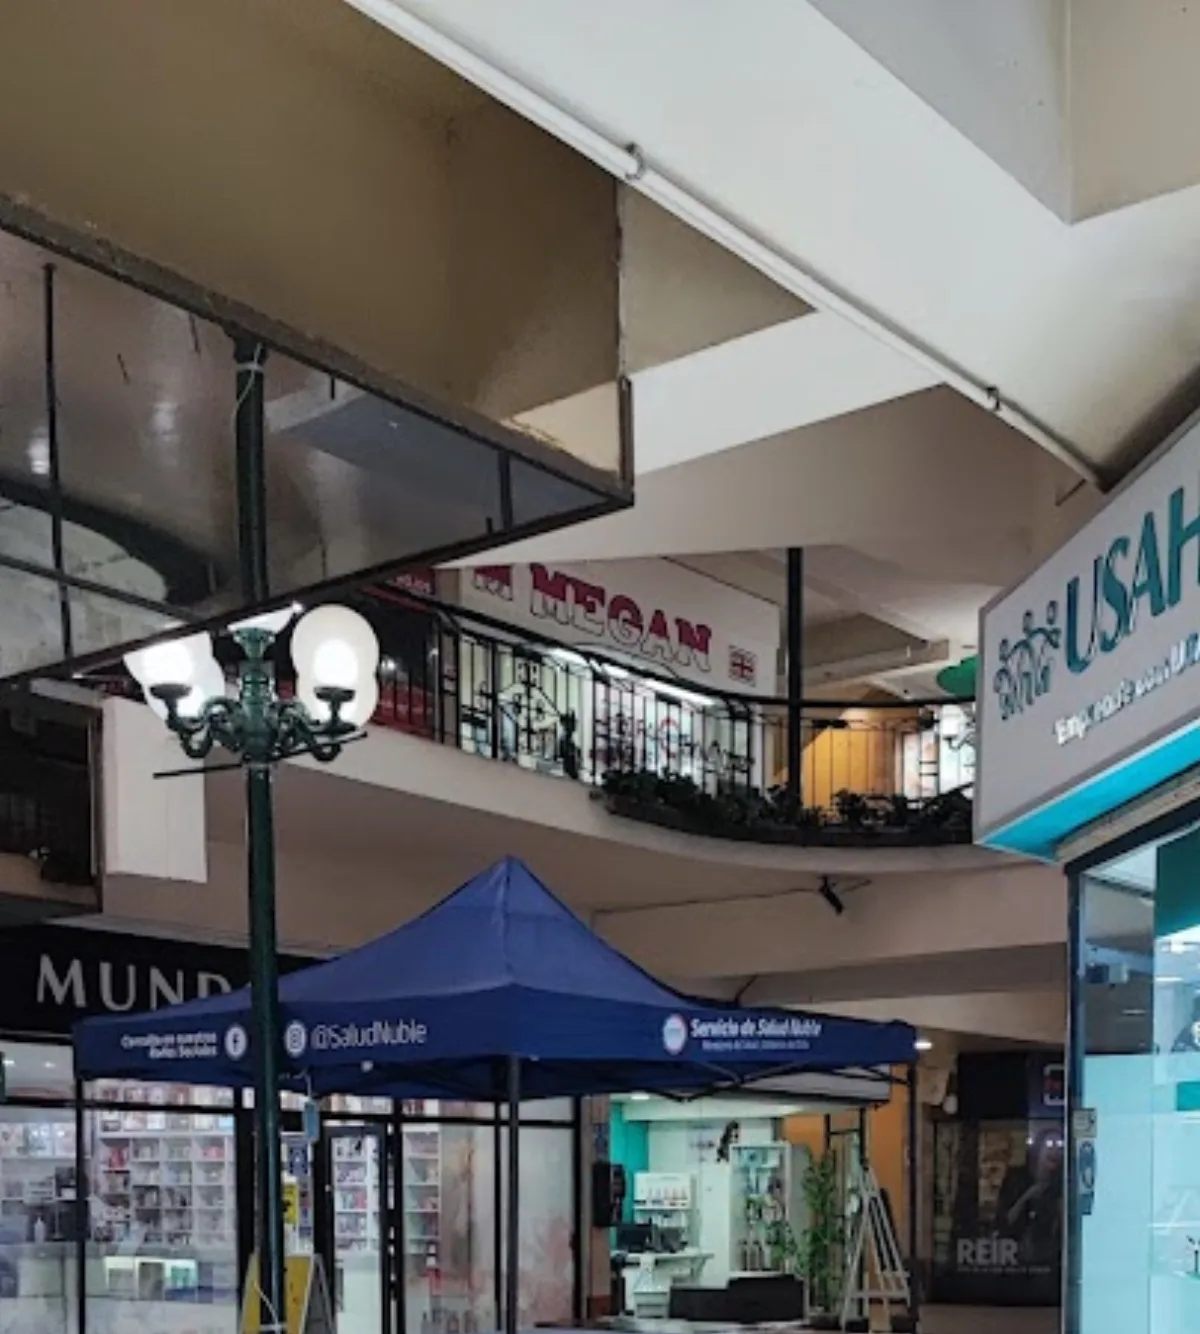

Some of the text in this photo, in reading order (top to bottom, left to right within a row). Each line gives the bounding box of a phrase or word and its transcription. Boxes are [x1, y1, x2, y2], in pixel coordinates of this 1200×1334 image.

[529, 562, 712, 674] MEGAN
[37, 953, 252, 1012] MUND
[690, 1017, 739, 1038] Servicio
[740, 1017, 756, 1038] de
